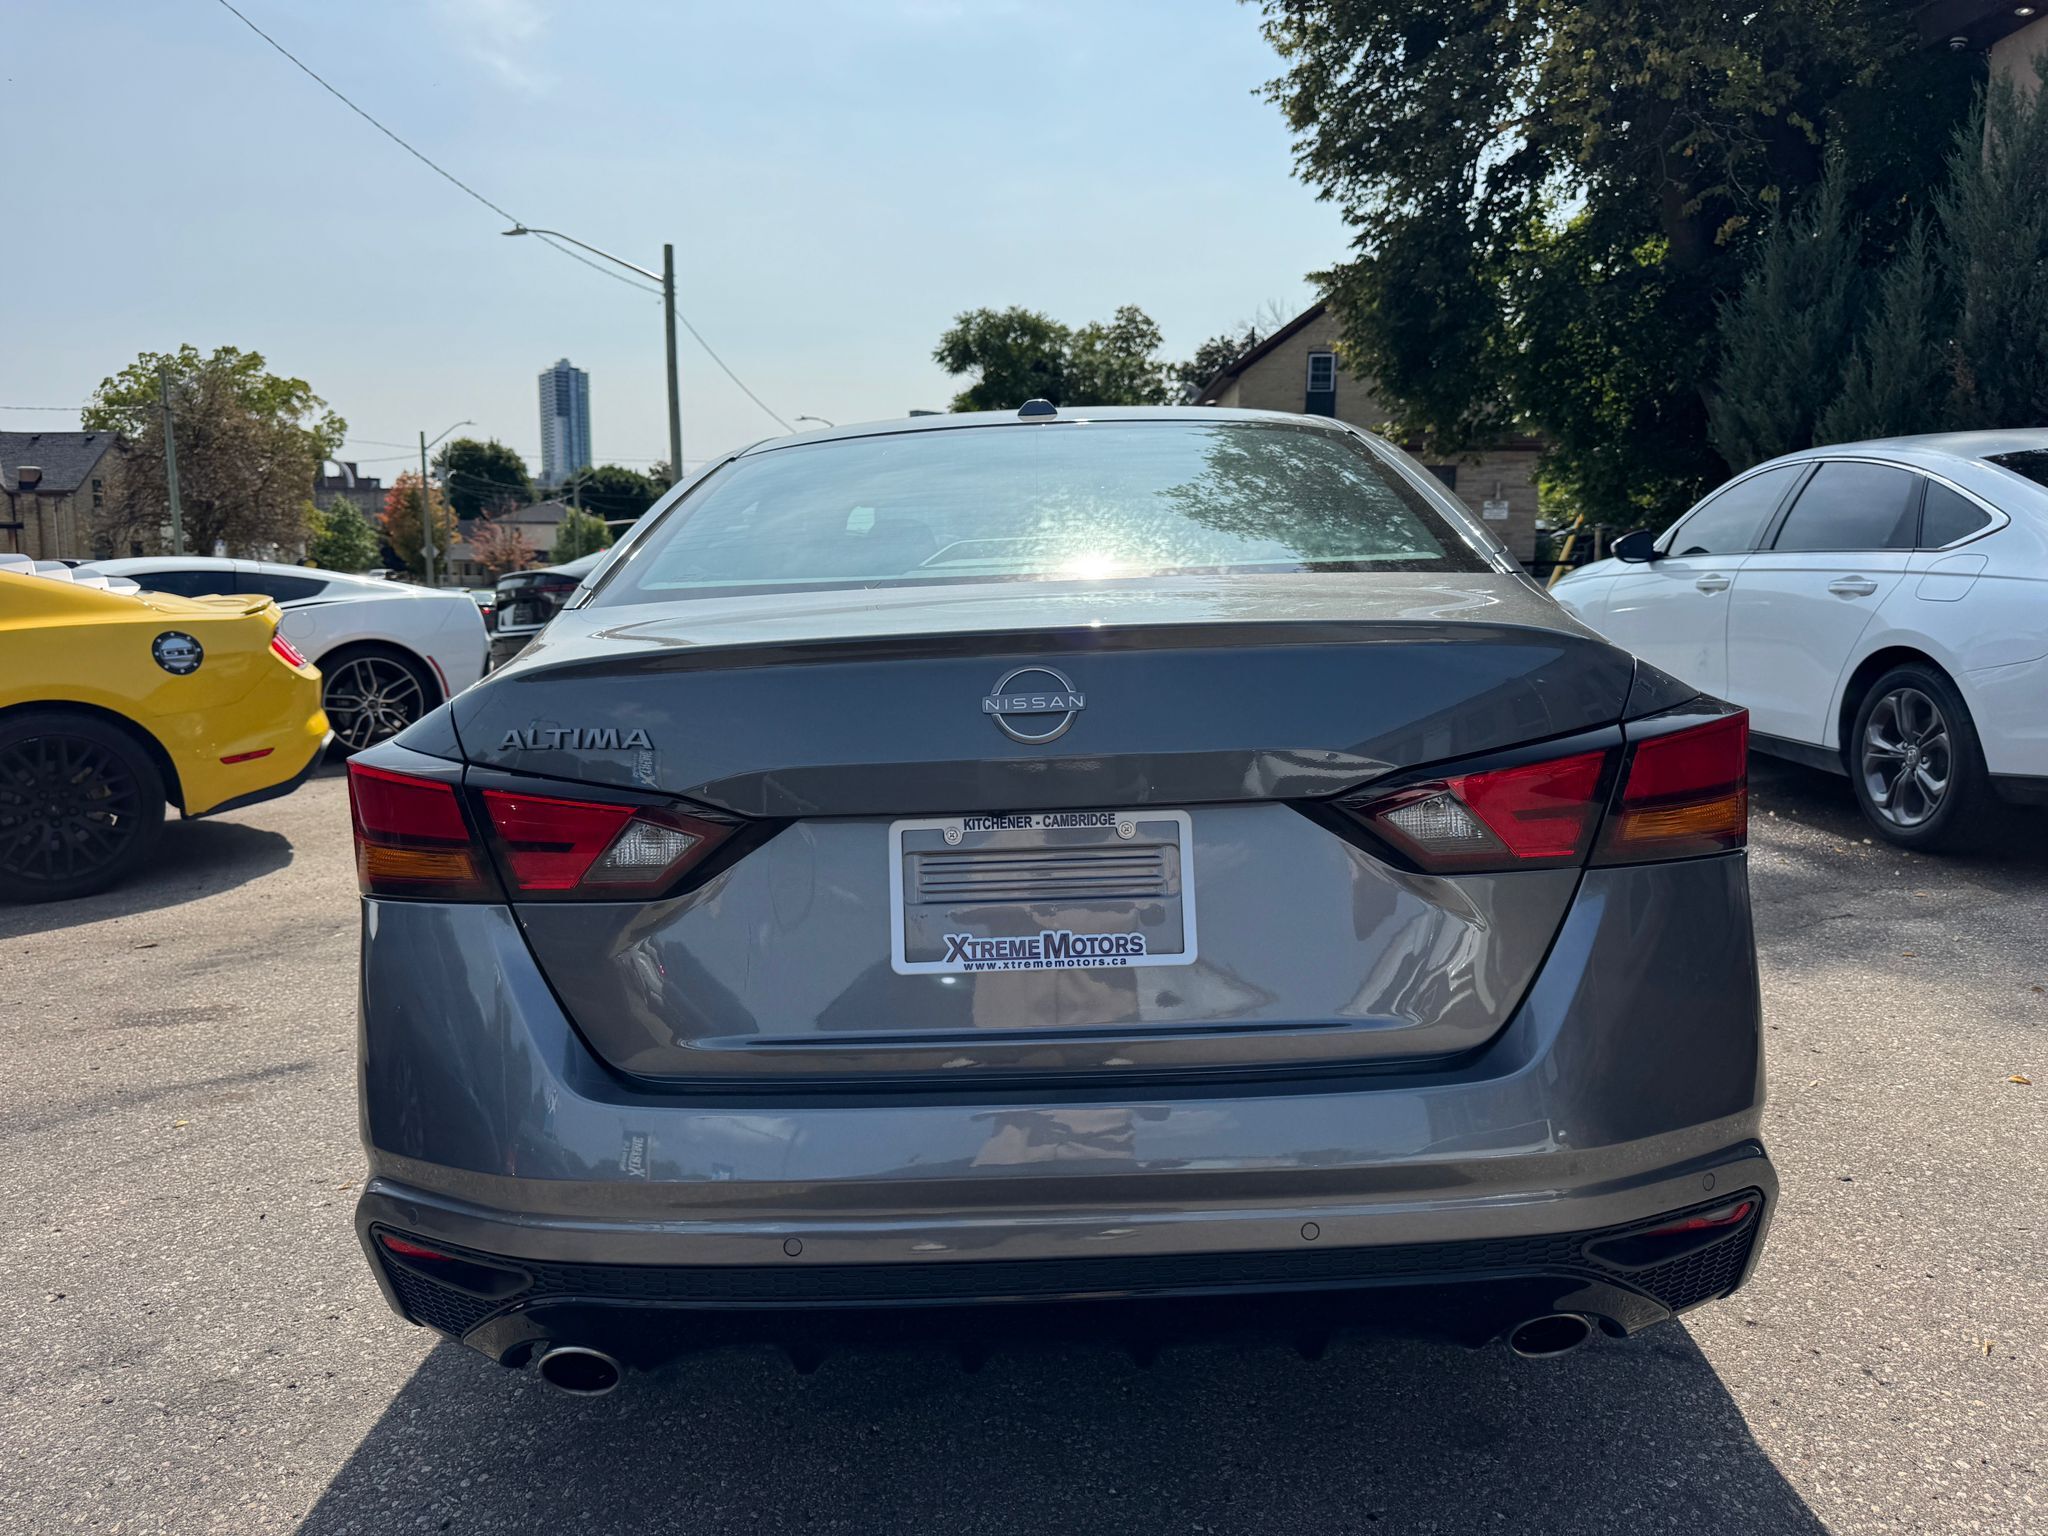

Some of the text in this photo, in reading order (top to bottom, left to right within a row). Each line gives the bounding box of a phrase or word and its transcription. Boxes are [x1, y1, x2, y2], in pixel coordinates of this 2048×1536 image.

[985, 695, 1084, 711] NISSAN
[500, 728, 654, 751] ALTIMA
[963, 816, 1032, 831] KITCHENER
[1043, 813, 1116, 828] CAMBRIDGE
[963, 957, 1127, 971] www.xtrememotors.ca
